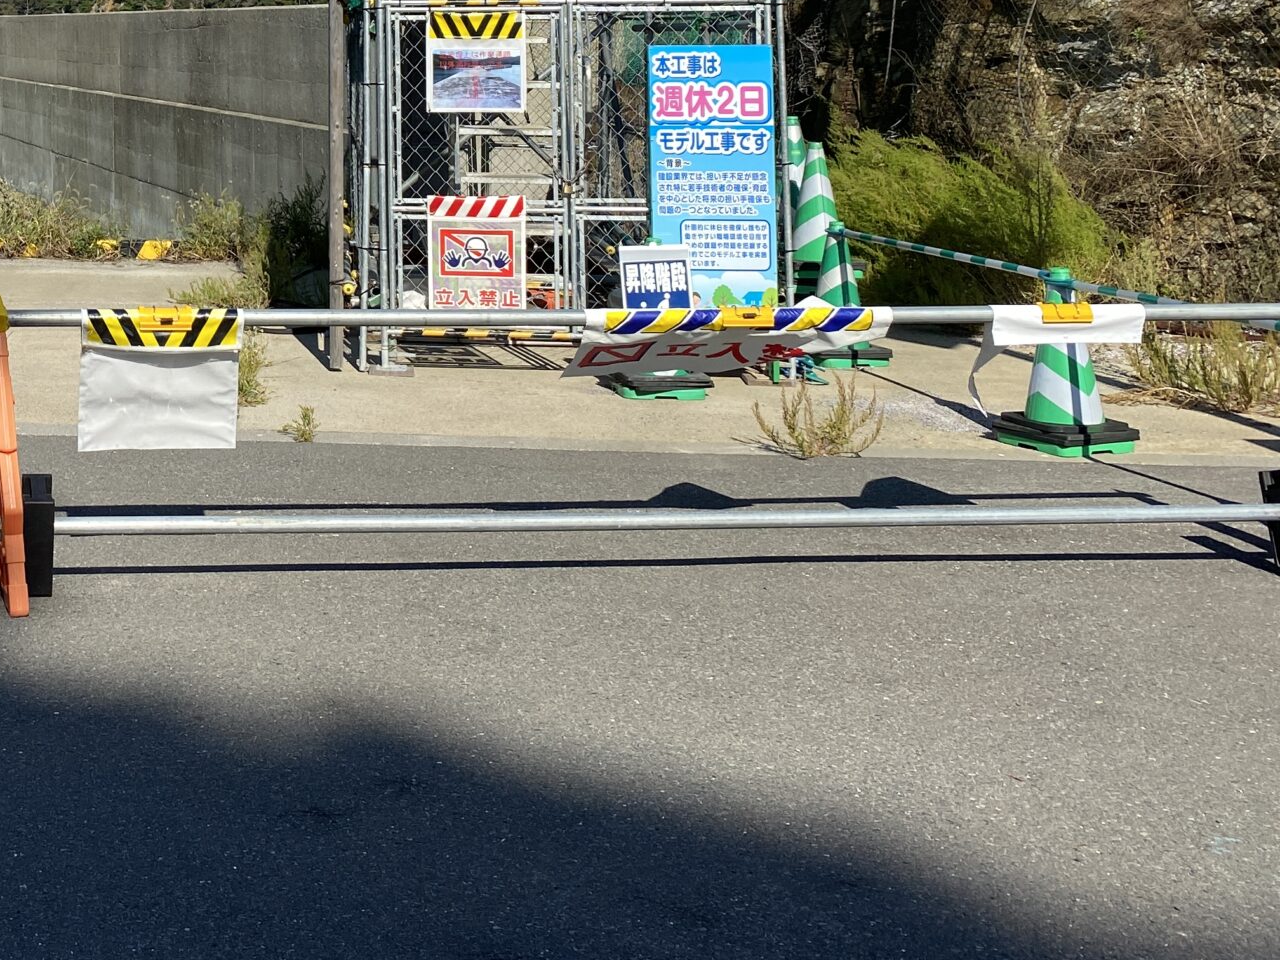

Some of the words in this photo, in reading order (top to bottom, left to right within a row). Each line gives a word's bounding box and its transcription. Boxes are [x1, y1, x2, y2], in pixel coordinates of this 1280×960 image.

[655, 55, 718, 74] 本工事は
[660, 132, 768, 152] モデル工事です
[625, 262, 687, 294] 昇降階段
[435, 289, 520, 308] 立入禁止
